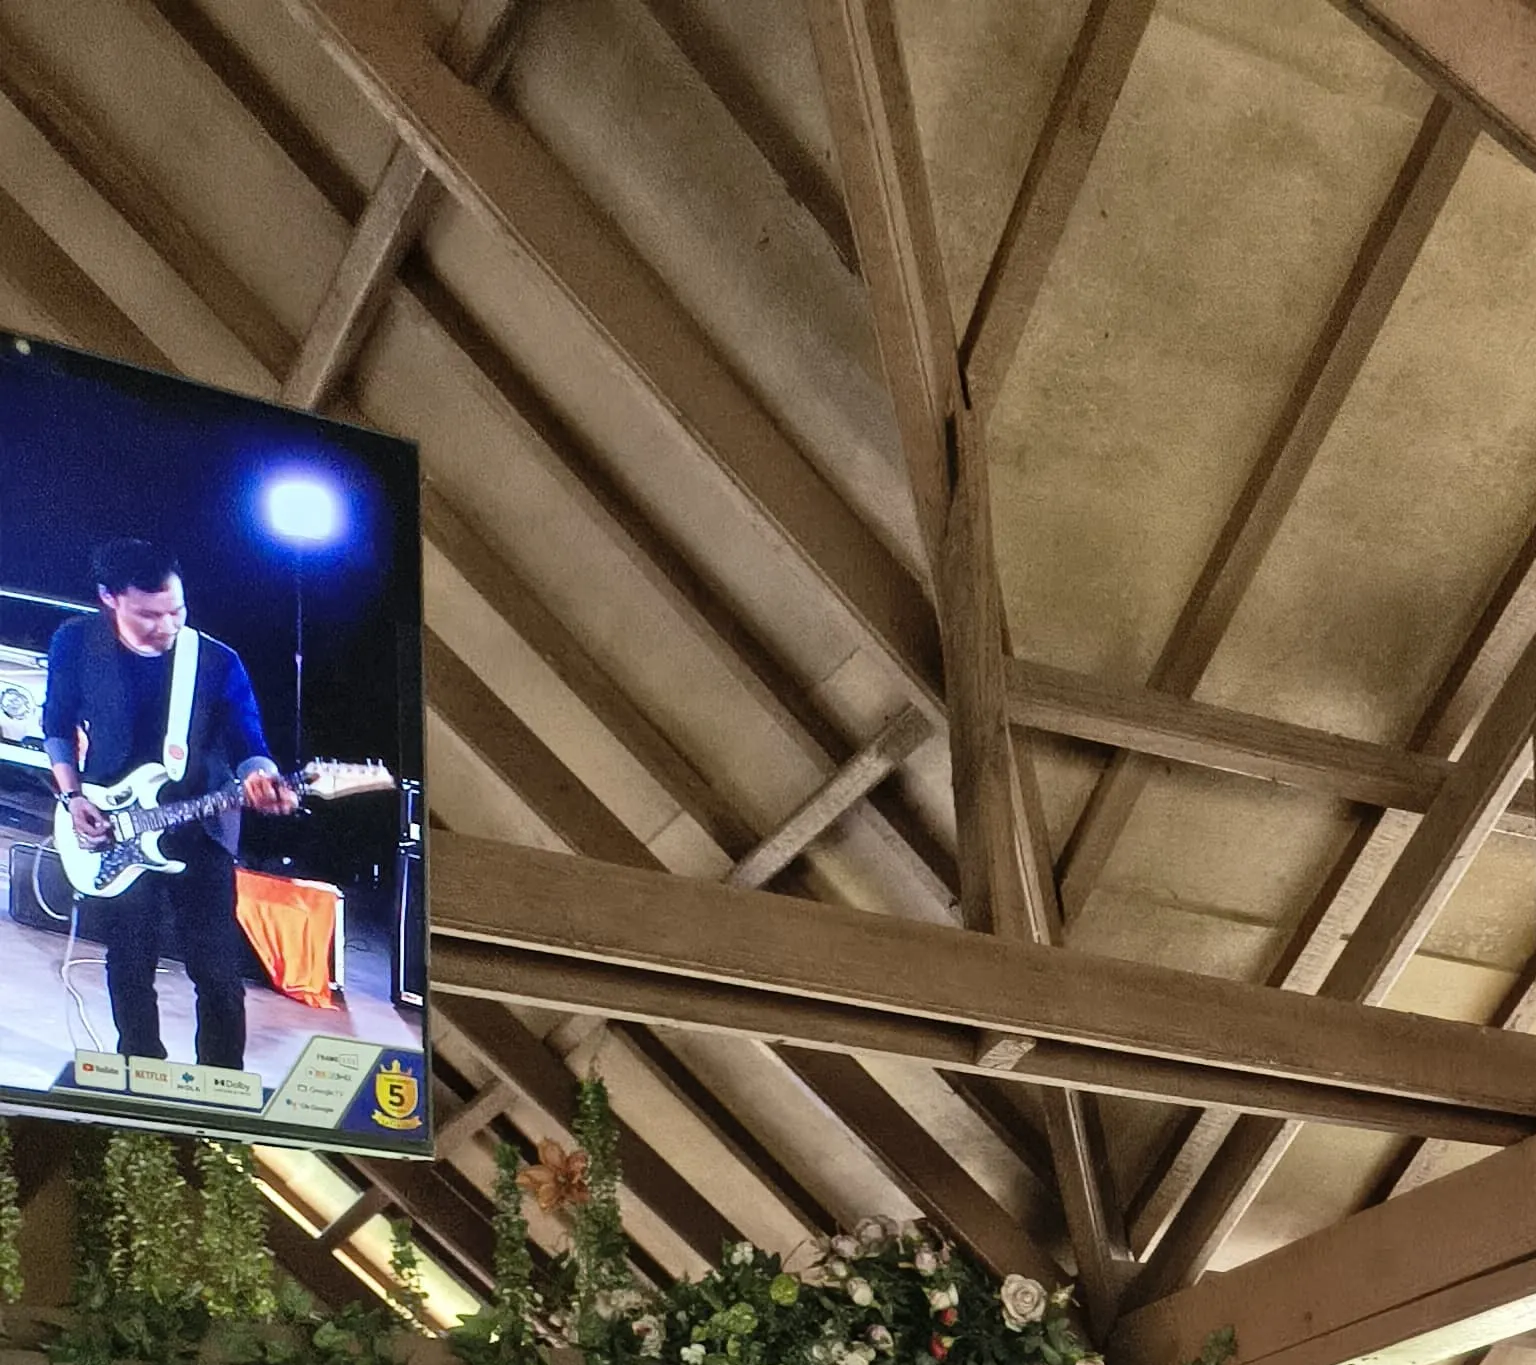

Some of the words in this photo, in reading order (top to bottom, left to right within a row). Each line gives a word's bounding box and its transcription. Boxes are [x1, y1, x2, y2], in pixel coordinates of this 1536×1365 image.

[135, 1069, 168, 1082] NETFLIX
[226, 1080, 250, 1092] Dolby
[389, 1083, 405, 1107] 5
